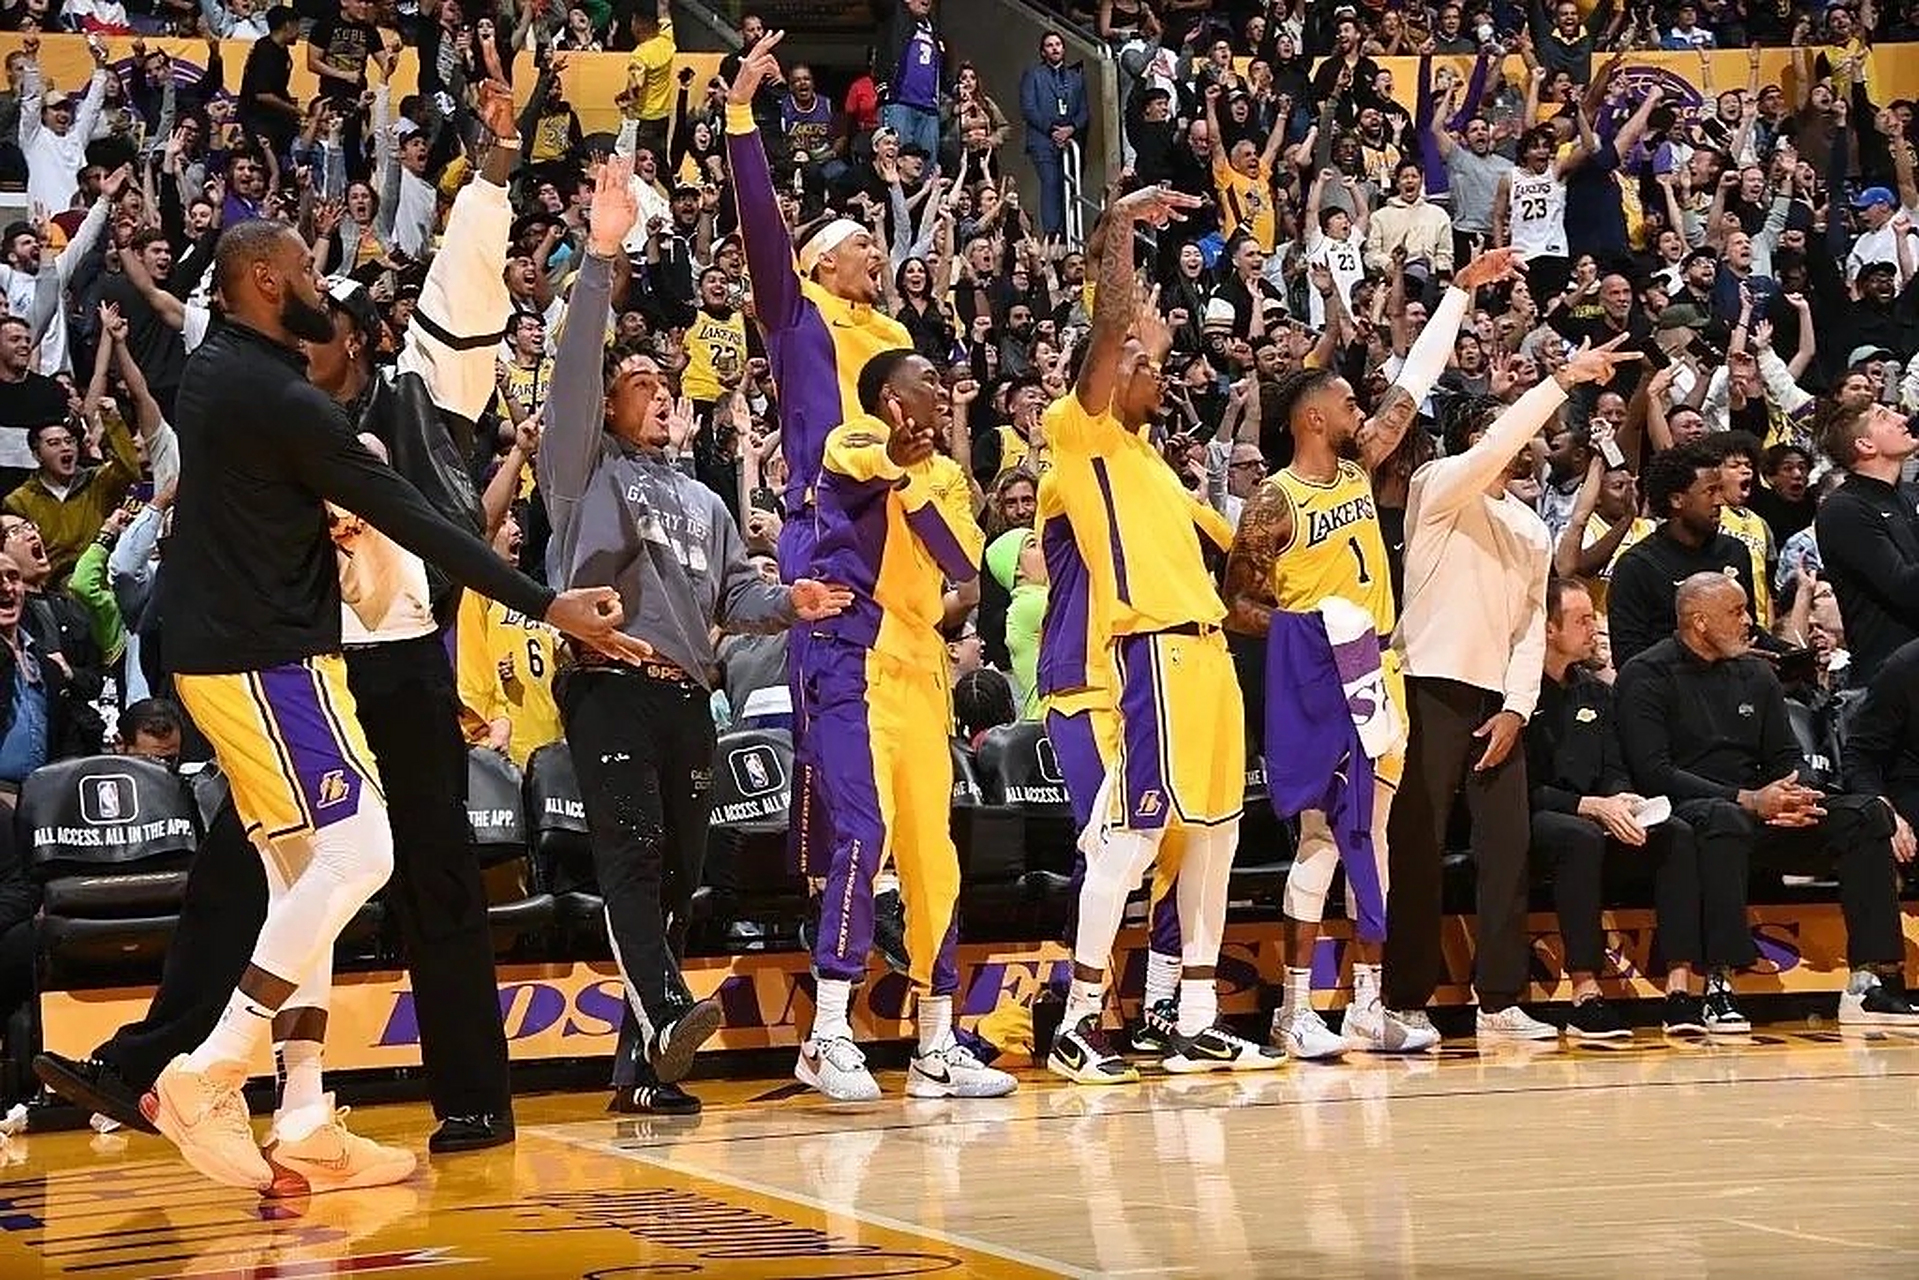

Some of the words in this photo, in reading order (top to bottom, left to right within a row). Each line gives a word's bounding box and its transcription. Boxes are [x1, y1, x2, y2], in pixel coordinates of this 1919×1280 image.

[1521, 198, 1547, 221] 23
[1337, 253, 1356, 271] 23
[698, 324, 743, 346] LAKERS
[1306, 494, 1375, 549] LAKERS
[1348, 536, 1371, 584] 1
[526, 638, 544, 678] 6
[1005, 786, 1025, 803] ALL
[1024, 786, 1063, 803] ACCESS.
[467, 809, 491, 828] THE
[490, 809, 515, 828] APP.
[545, 798, 564, 815] ALL
[565, 800, 586, 819] ACC
[723, 801, 763, 822] ACCESS.
[763, 796, 782, 814] ALL
[34, 826, 57, 848] ALL
[57, 826, 104, 847] ACCESS.
[105, 827, 128, 847] ALL
[127, 825, 143, 844] IN
[142, 819, 166, 841] THE
[166, 817, 193, 837] APP.
